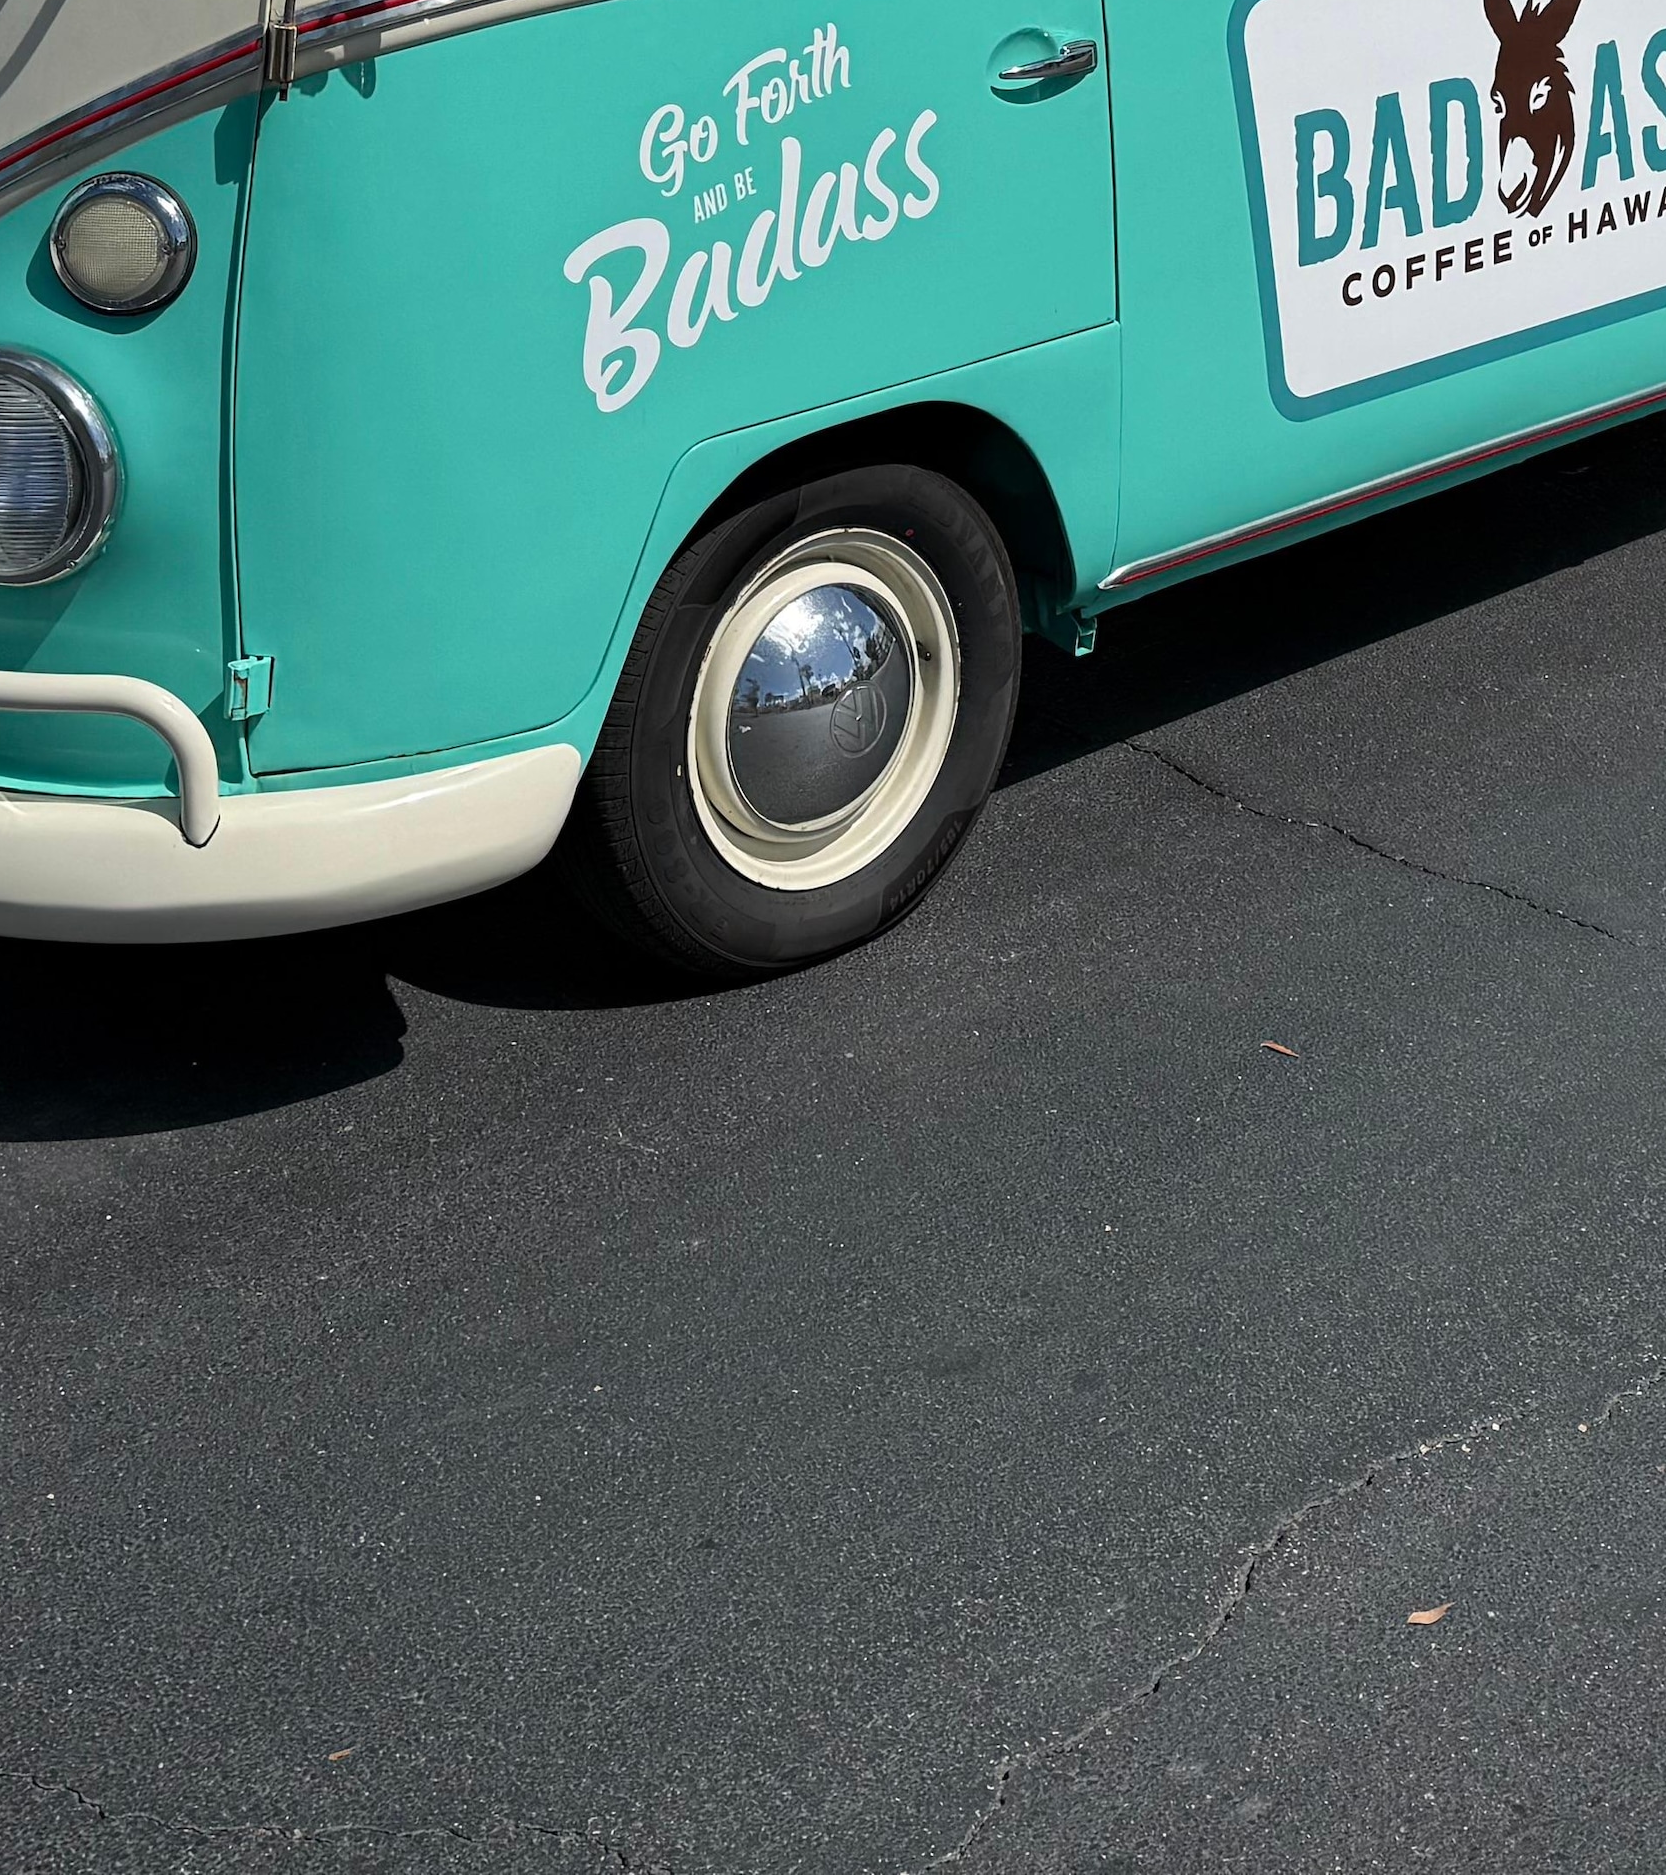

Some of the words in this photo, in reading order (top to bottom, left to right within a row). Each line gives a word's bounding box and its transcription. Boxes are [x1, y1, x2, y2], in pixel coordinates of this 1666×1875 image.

[639, 104, 719, 197] Go
[722, 22, 851, 145] Forth
[693, 182, 728, 224] AND
[734, 167, 757, 202] BE
[1295, 76, 1485, 268] BAD
[563, 108, 941, 414] Badass
[1341, 229, 1513, 308] COFFEE
[1528, 225, 1553, 248] OF
